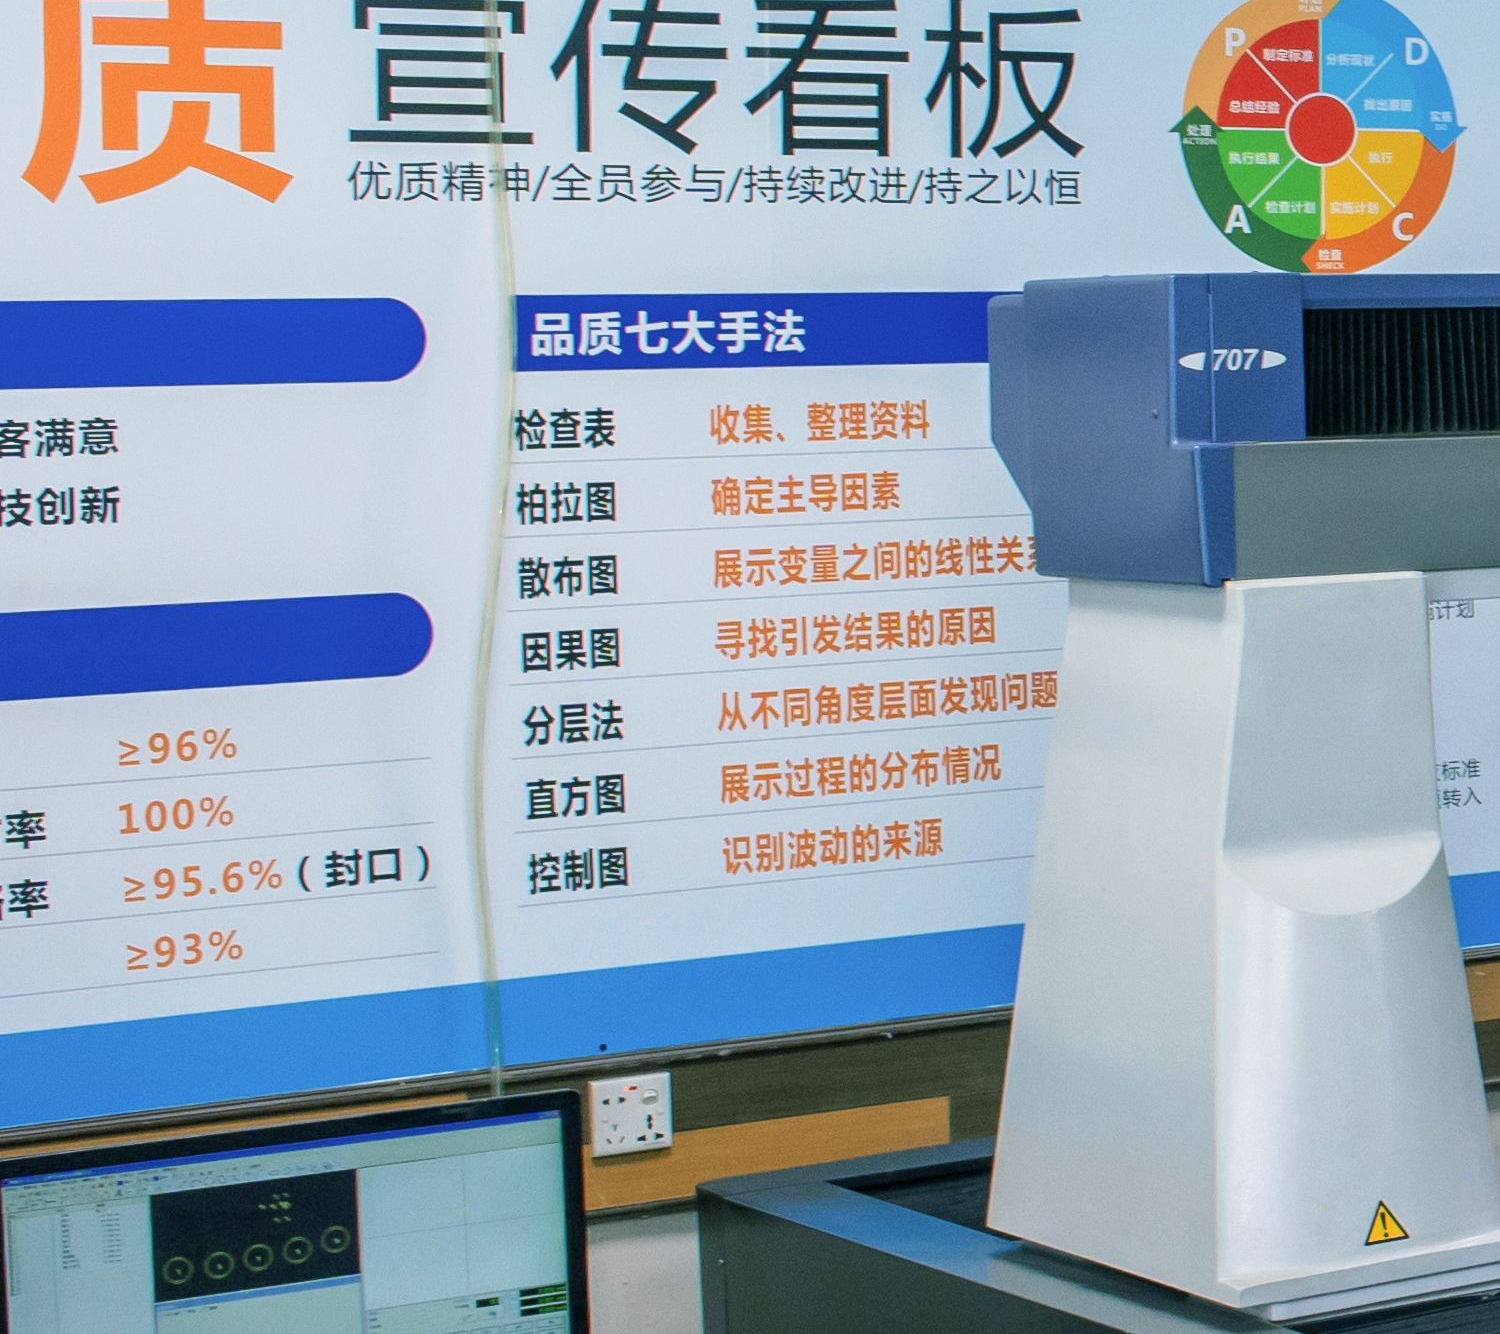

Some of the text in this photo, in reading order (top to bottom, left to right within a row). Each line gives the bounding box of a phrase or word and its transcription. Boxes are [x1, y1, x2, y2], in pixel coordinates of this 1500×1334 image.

[1224, 26, 1246, 57] P
[1404, 36, 1428, 66] D
[1224, 204, 1253, 234] A
[1391, 212, 1415, 242] C
[530, 308, 807, 358] 品质七大手法
[1212, 347, 1260, 372] 707
[513, 398, 931, 451] 检查表 收集、整理资料
[515, 470, 901, 526] 柏拉图 确定主导因素
[517, 554, 620, 600] 散布图
[521, 605, 997, 674] 因果图 寻找引发结果的原因
[522, 669, 1060, 748] 分层法 从不同角度层面发现问题
[525, 743, 1003, 821] 直方图 展示过程的分布情况
[118, 794, 235, 836] 100%
[528, 816, 945, 896] 控制图 识别波动的来源
